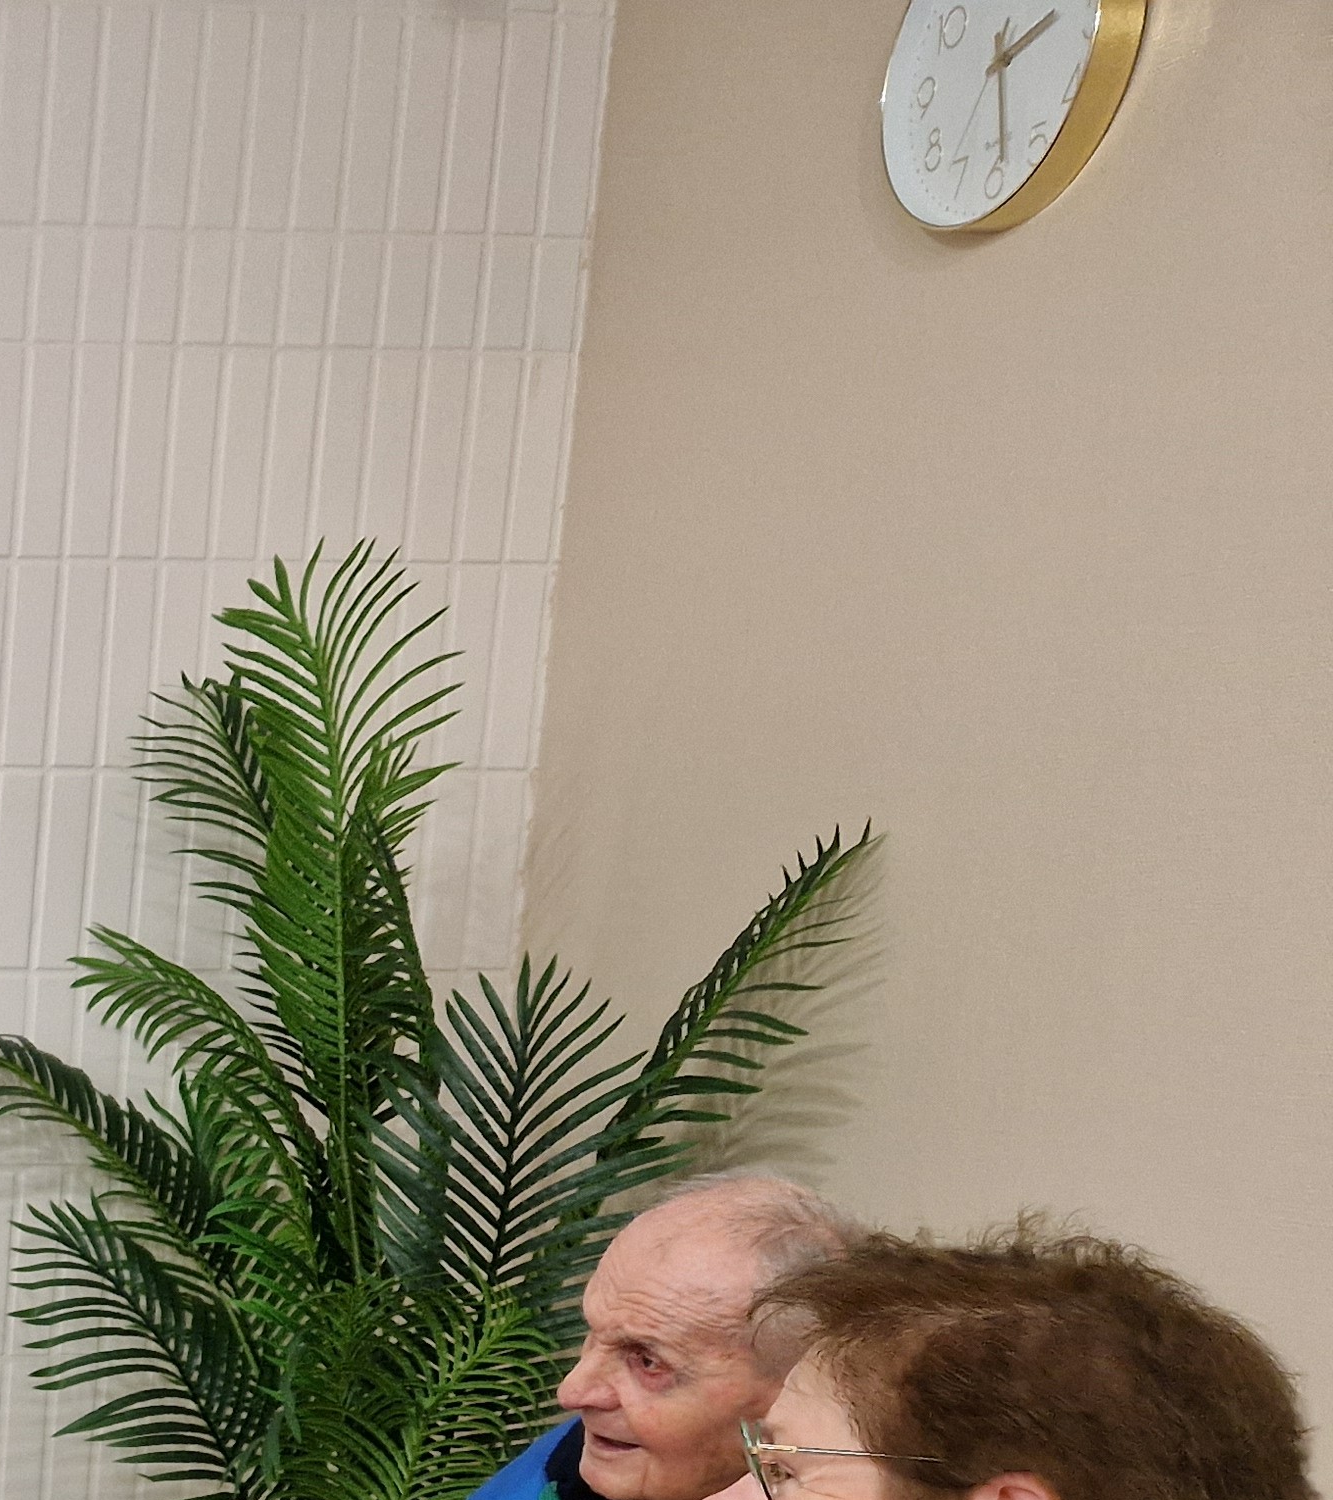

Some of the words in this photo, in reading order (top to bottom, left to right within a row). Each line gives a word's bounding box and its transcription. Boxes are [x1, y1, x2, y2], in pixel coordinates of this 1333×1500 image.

[937, 5, 967, 55] 10
[916, 76, 936, 119] 9
[925, 127, 941, 172] 8
[1027, 120, 1048, 166] 5
[949, 155, 969, 199] 7
[985, 155, 1005, 199] 6
